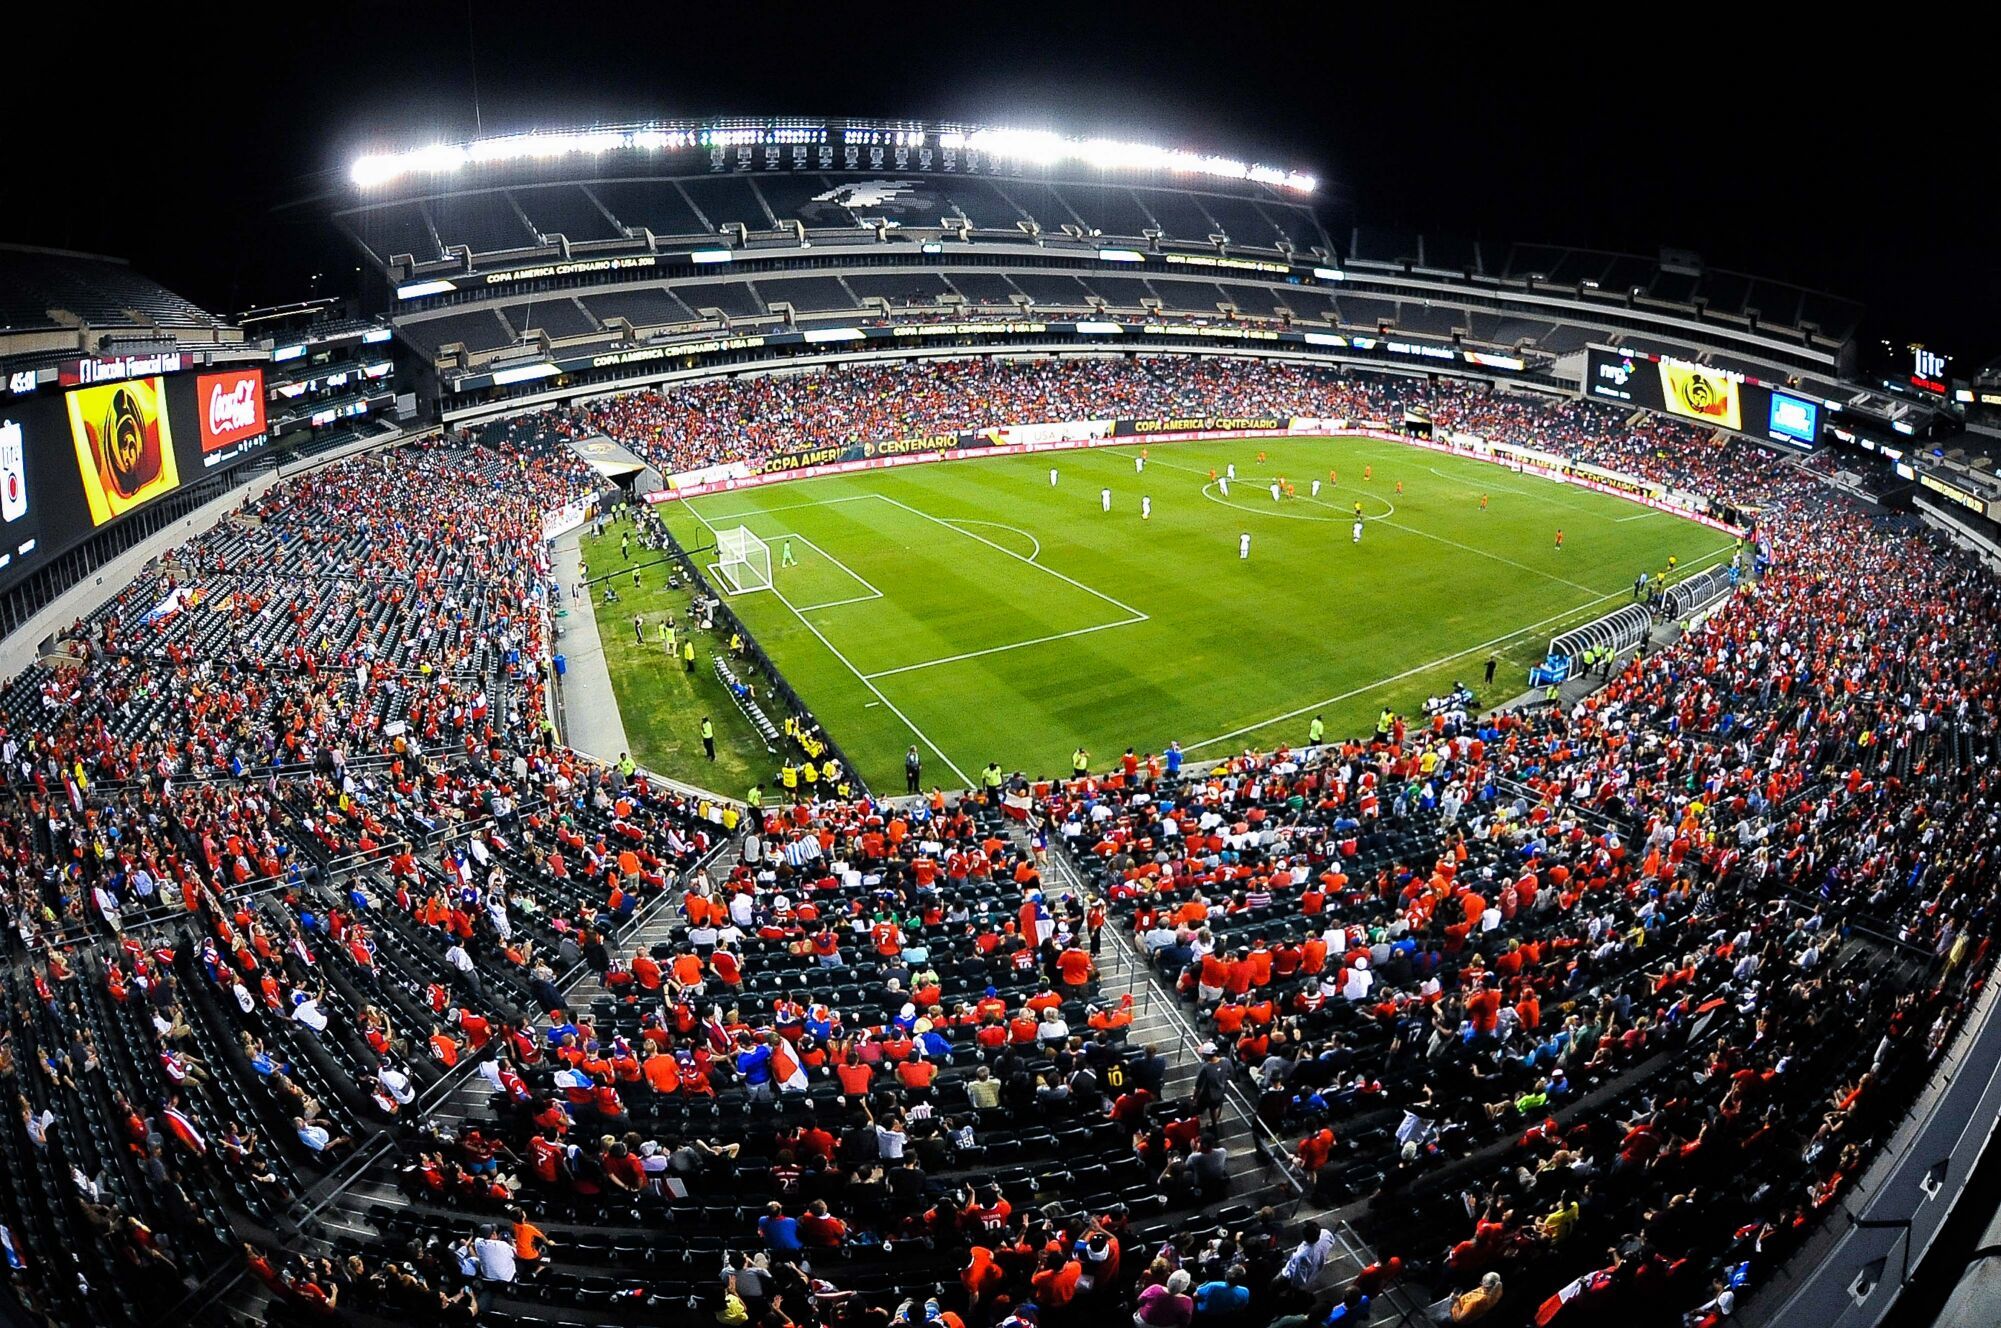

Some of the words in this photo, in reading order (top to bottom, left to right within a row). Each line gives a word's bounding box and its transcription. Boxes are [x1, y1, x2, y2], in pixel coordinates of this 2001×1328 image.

[486, 272, 513, 284] COPA
[513, 267, 555, 280] AMERICA
[556, 260, 611, 275] CENTENARIO
[620, 258, 638, 268] USA
[593, 355, 620, 368] COPA
[620, 349, 665, 363] AMERICA
[665, 341, 720, 357] CENTENARIO
[92, 356, 125, 381] Lincoln
[125, 354, 161, 377] Financial
[162, 352, 181, 373] Field
[1914, 347, 1945, 380] Lite
[1135, 421, 1161, 433] COPA
[1163, 419, 1204, 432] AMERICA
[764, 455, 800, 473] COPA
[878, 434, 958, 454] CENTENARIO
[952, 858, 958, 871] 7
[756, 916, 764, 925] 8
[880, 932, 889, 945] 7
[1107, 1071, 1123, 1087] 10
[537, 1152, 547, 1166] 7
[983, 1219, 1002, 1231] 10
